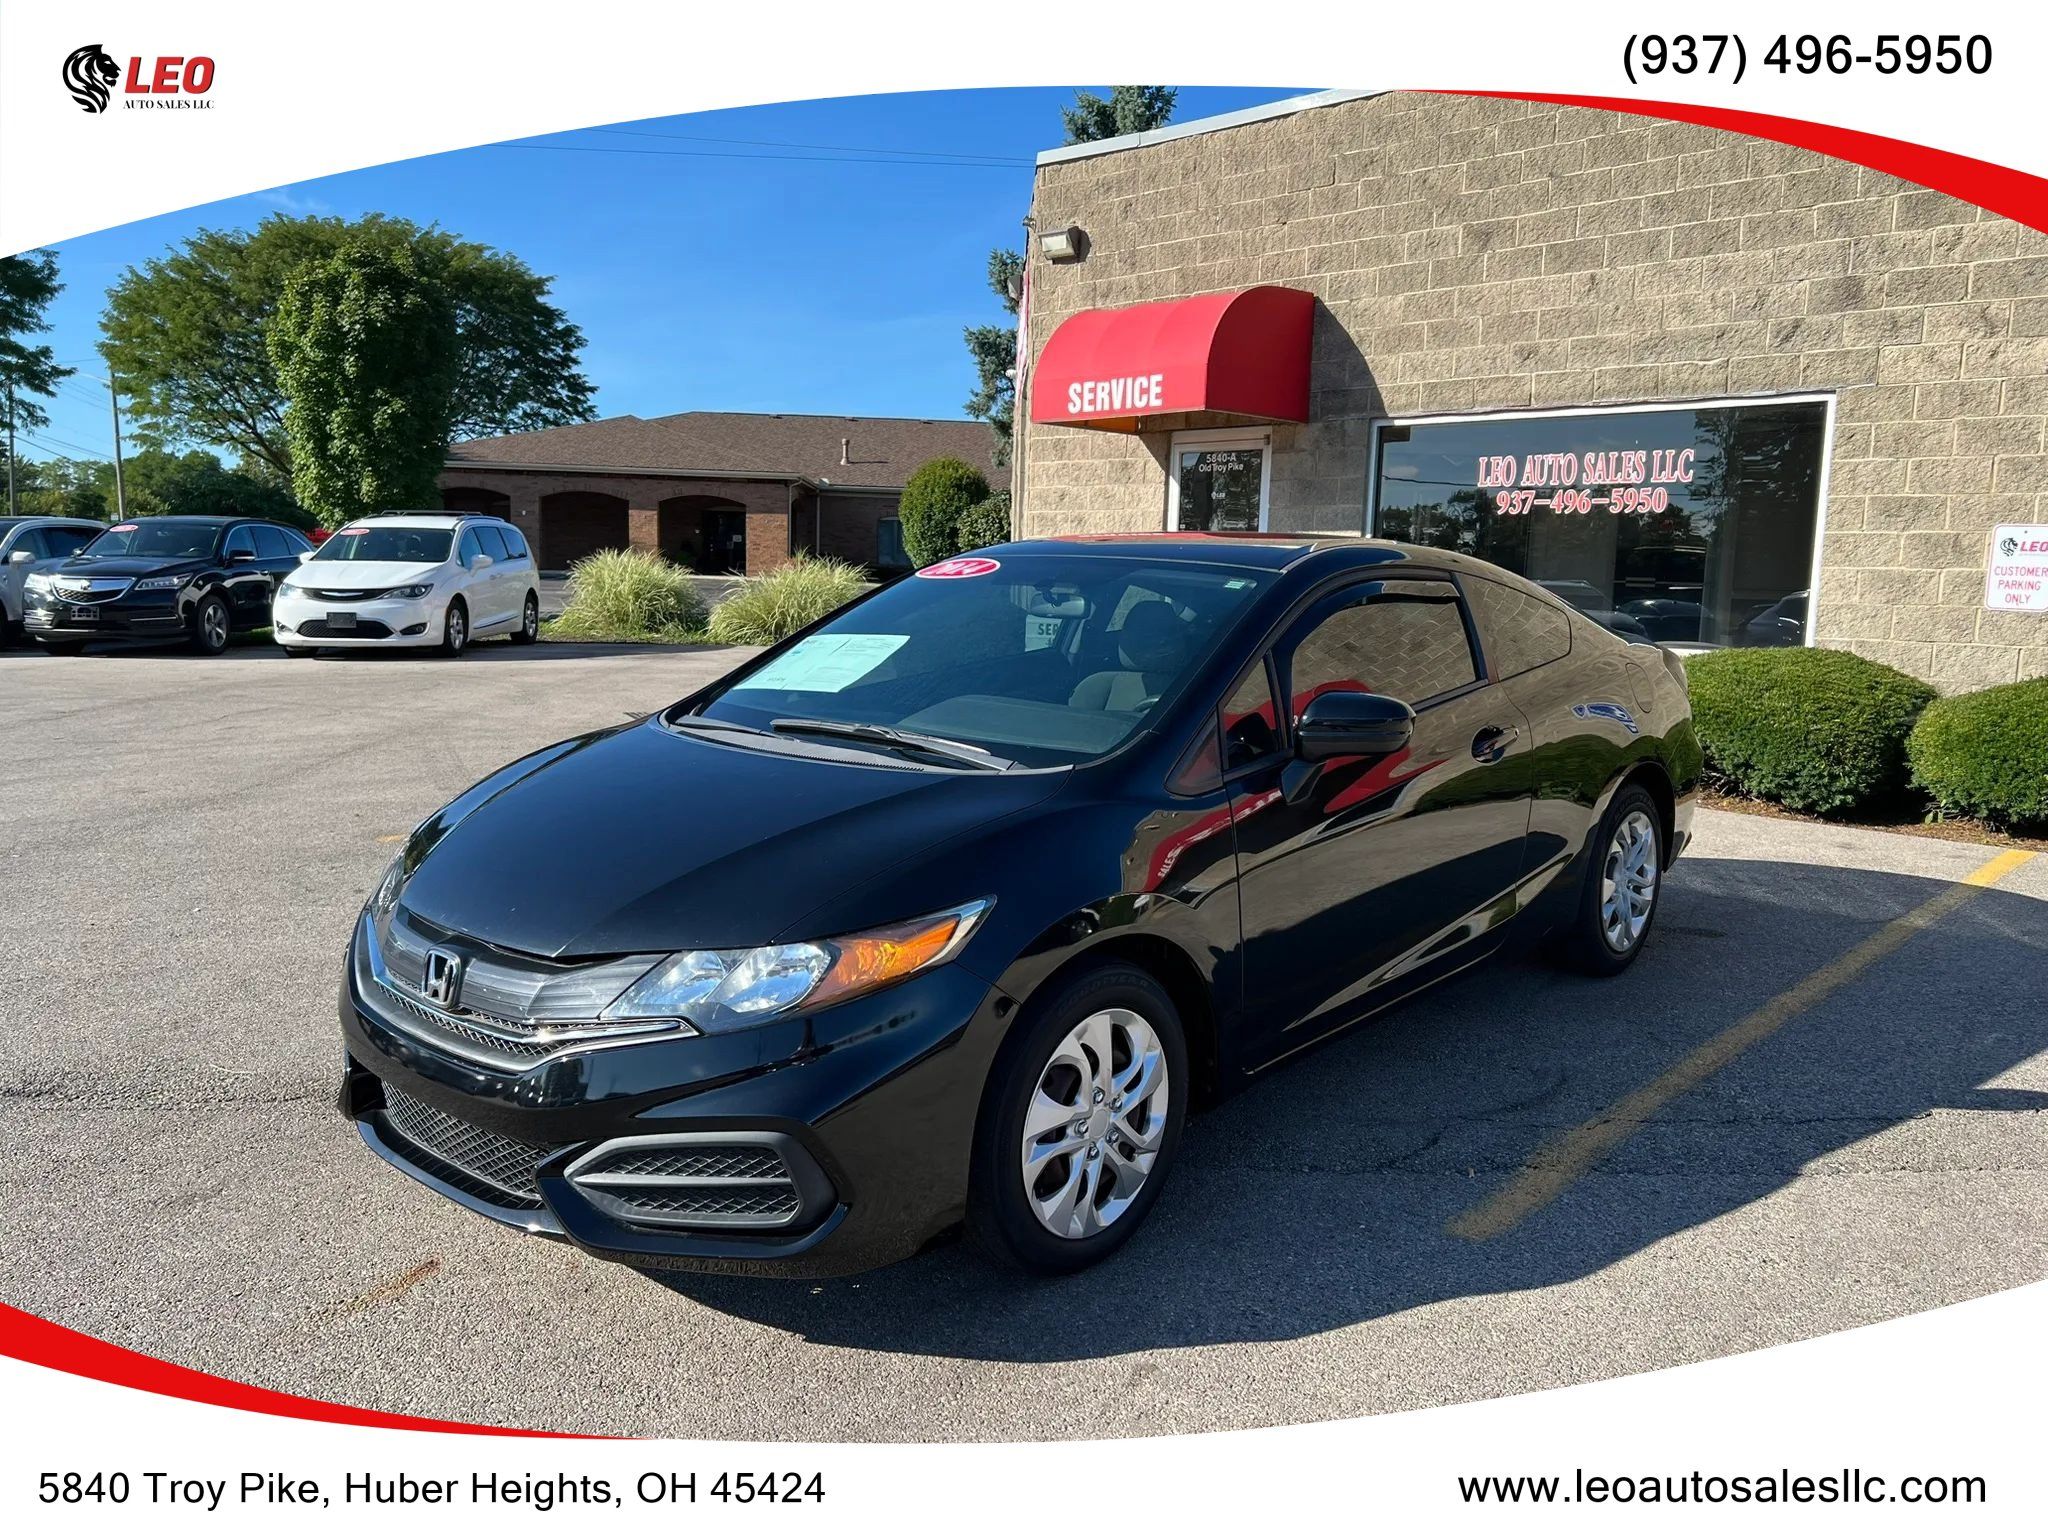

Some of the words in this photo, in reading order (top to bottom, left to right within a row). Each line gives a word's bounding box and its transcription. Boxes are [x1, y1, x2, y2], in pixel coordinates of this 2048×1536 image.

[1067, 374, 1164, 415] SERVICE
[1206, 453, 1237, 463] 5840-A
[1199, 464, 1212, 473] Old
[1212, 463, 1227, 473] Troy
[1228, 462, 1244, 471] Pike
[1477, 455, 1517, 488] LEO
[1520, 453, 1579, 486] AUTO
[1582, 451, 1647, 485] SALES
[1651, 448, 1696, 483] LLC
[1496, 487, 1669, 515] 937-496-5950
[2020, 541, 2048, 552] LEO
[1994, 566, 2048, 577] CUSTOMER
[1998, 580, 2042, 591] PARKING
[2004, 593, 2031, 605] ONLY
